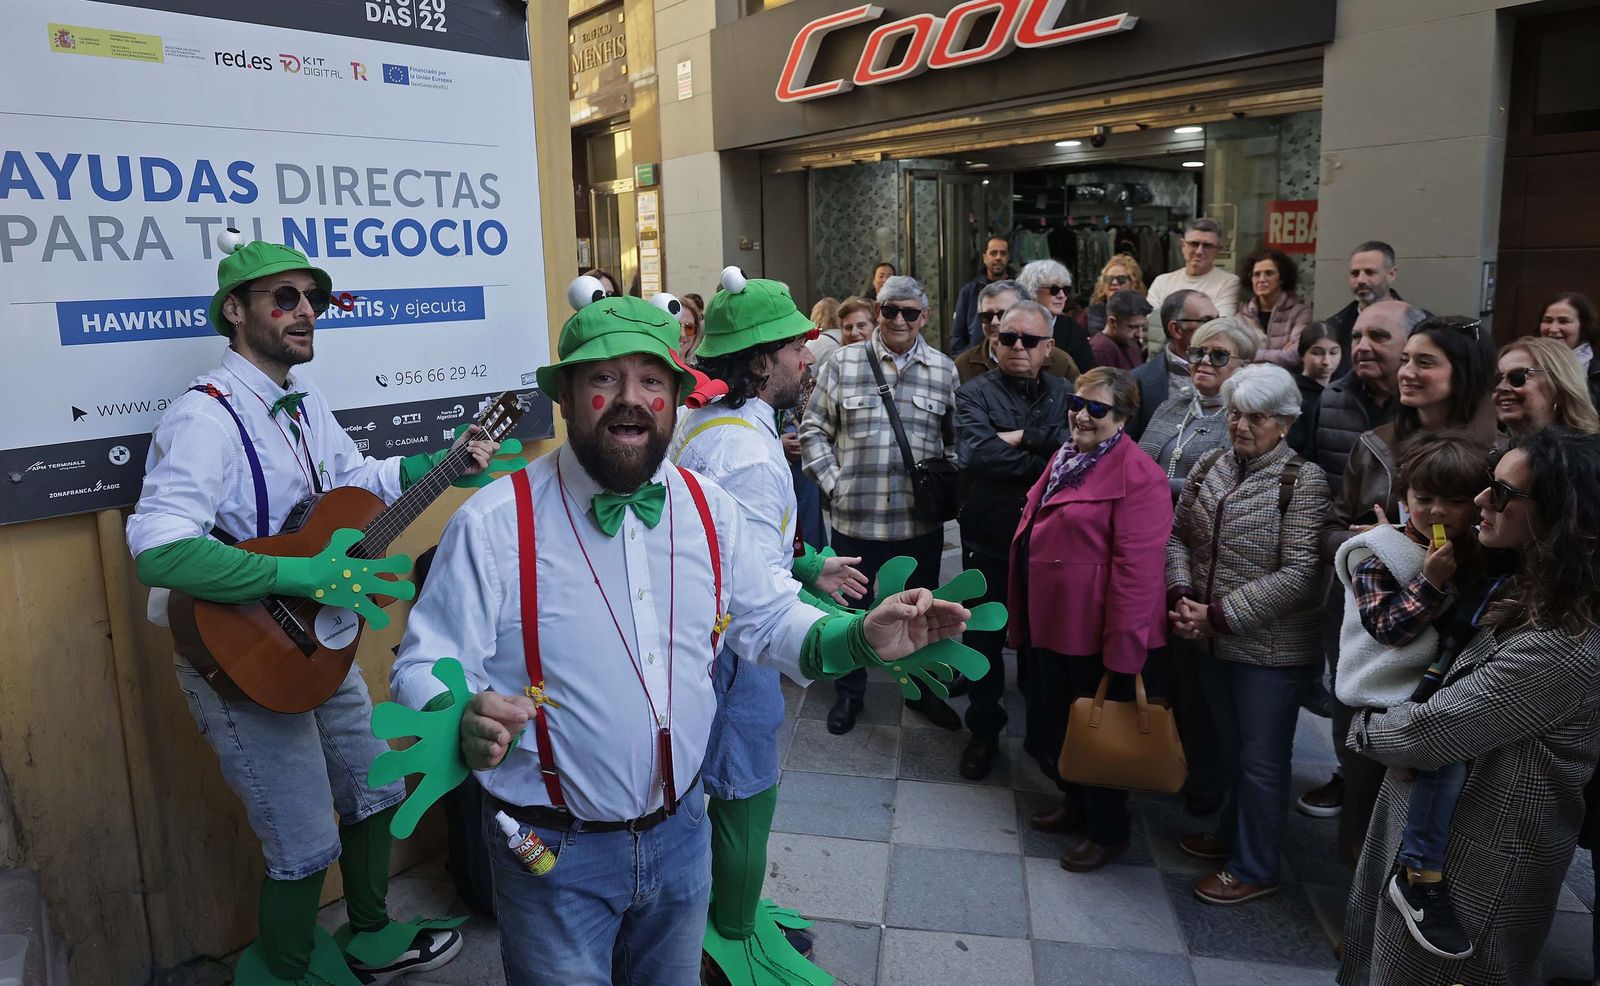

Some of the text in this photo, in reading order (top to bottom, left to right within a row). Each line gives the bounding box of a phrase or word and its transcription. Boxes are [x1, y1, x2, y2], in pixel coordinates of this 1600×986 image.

[365, 2, 447, 33] DAS 22
[214, 50, 273, 71] red.es
[302, 56, 325, 66] KIT
[571, 34, 626, 75] MENFIS
[303, 67, 343, 79] DIGITAL
[409, 66, 437, 75] Financiado
[432, 76, 453, 84] Europea
[0, 150, 502, 210] AYUDAS DIRECTAS
[0, 214, 174, 263] PARA
[282, 217, 508, 258] NEGOCIO
[82, 308, 206, 333] HAWKINS
[389, 304, 400, 320] y
[405, 299, 466, 319] ejecuta
[395, 363, 487, 386] 956 66 29 42
[395, 435, 429, 446] CADIMAR
[48, 460, 86, 469] TERMINALS
[49, 483, 120, 499] ZONAFRANCA CÁDIZ
